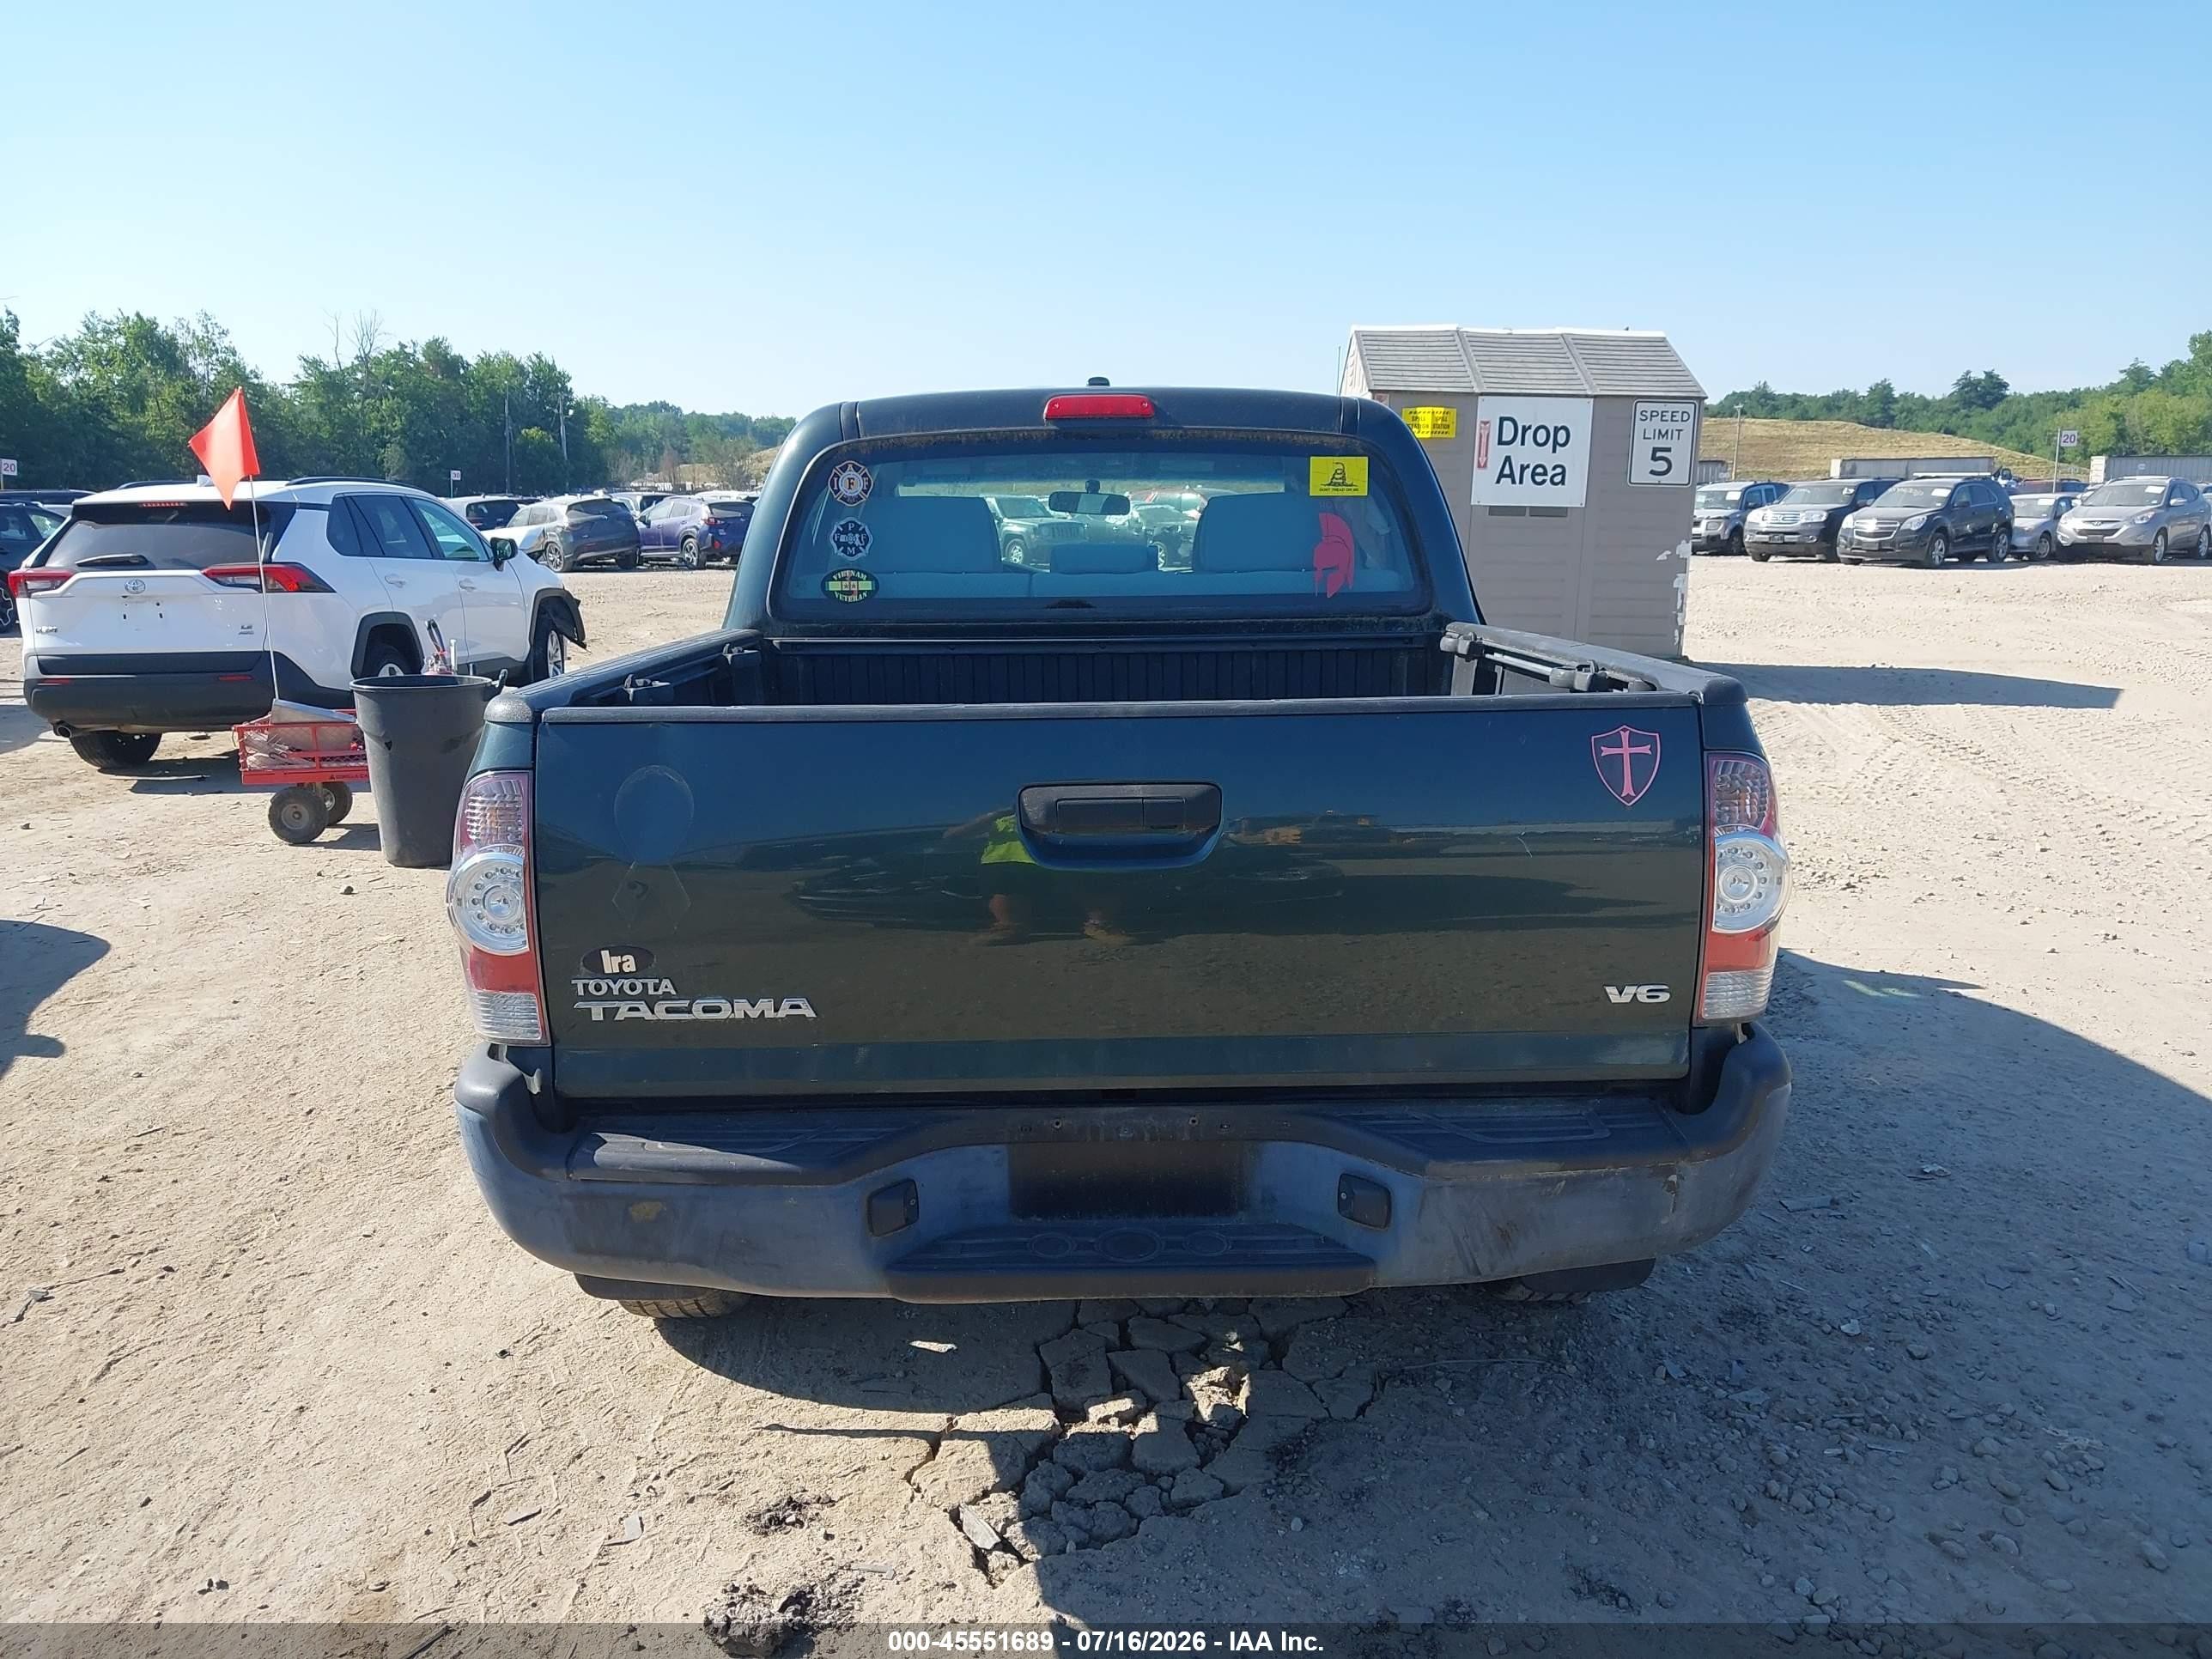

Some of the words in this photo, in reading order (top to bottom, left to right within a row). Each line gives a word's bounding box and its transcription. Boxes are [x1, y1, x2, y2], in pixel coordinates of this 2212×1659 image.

[1639, 410, 1690, 422] SPEED
[1497, 416, 1571, 453] Drop
[1643, 428, 1683, 441] LIMIT
[2063, 434, 2076, 444] 20
[3, 463, 15, 472] 20
[1649, 447, 1673, 476] 5
[1495, 455, 1567, 486] Area
[848, 522, 855, 531] P
[847, 546, 856, 555] M
[832, 570, 867, 580] VIETNAM
[834, 590, 868, 603] VETERAN
[601, 950, 636, 974] Ira
[571, 978, 677, 996] TOYOTA
[1603, 985, 1670, 1003] V6
[574, 998, 817, 1021] TACOMA
